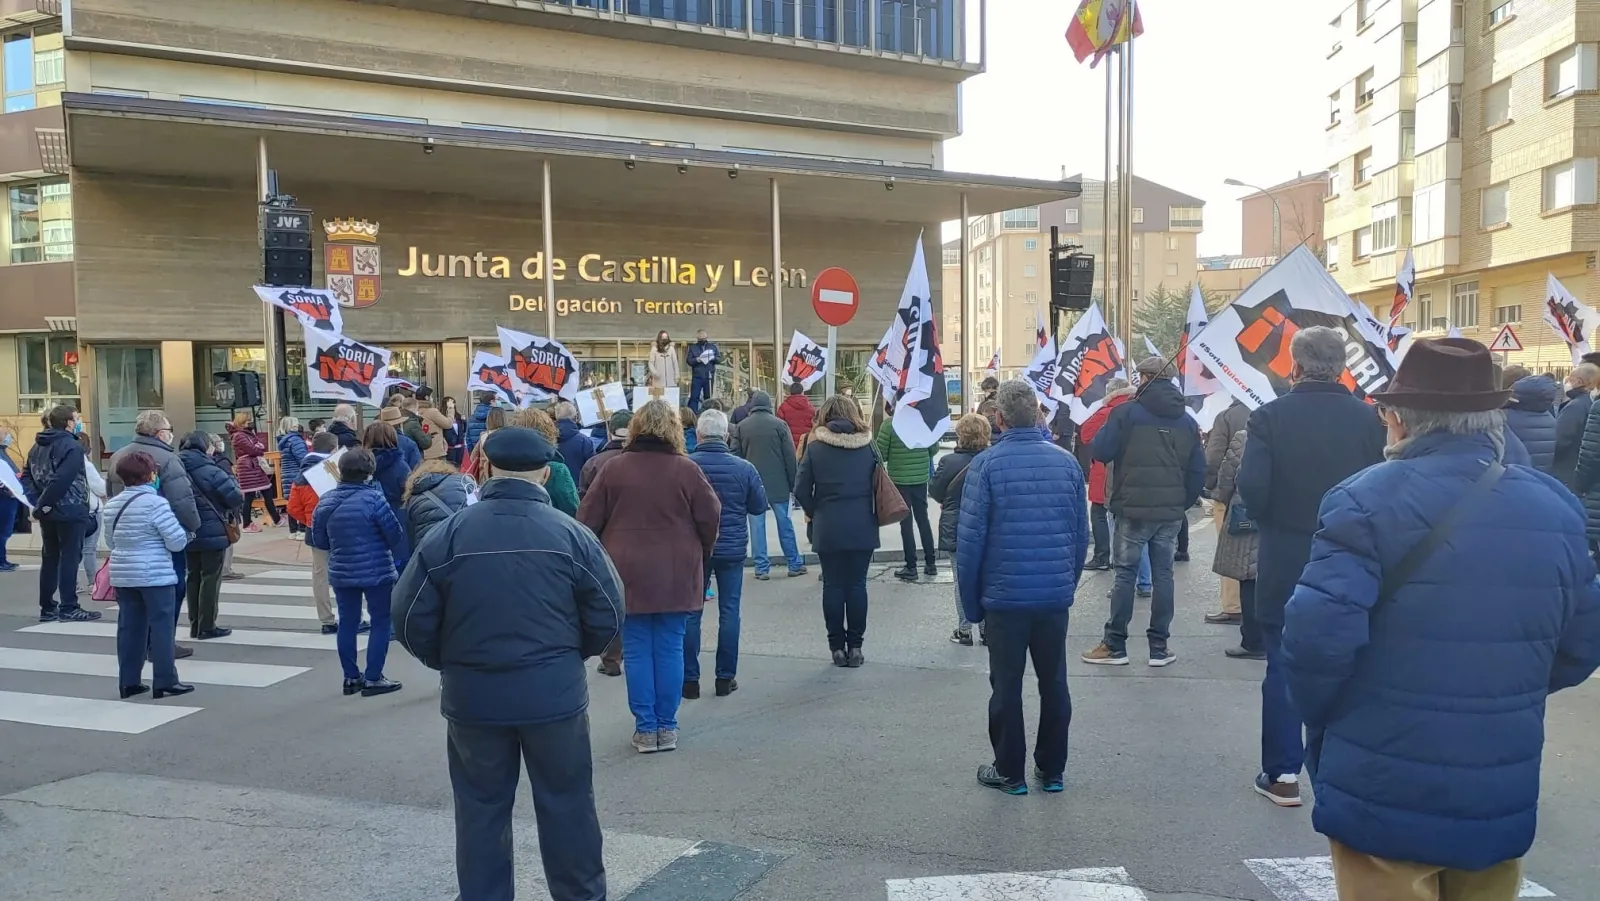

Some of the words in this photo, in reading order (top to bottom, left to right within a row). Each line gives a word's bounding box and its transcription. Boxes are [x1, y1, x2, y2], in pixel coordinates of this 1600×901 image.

[276, 216, 301, 229] JVF
[398, 246, 510, 279] Junta
[521, 252, 566, 281] de
[577, 253, 696, 285] Castilla
[703, 263, 724, 293] y
[1076, 259, 1090, 269] JVF
[509, 294, 622, 317] Delgación
[634, 298, 723, 316] Territorial
[338, 345, 375, 366] SORIA
[530, 348, 566, 370] SORIA
